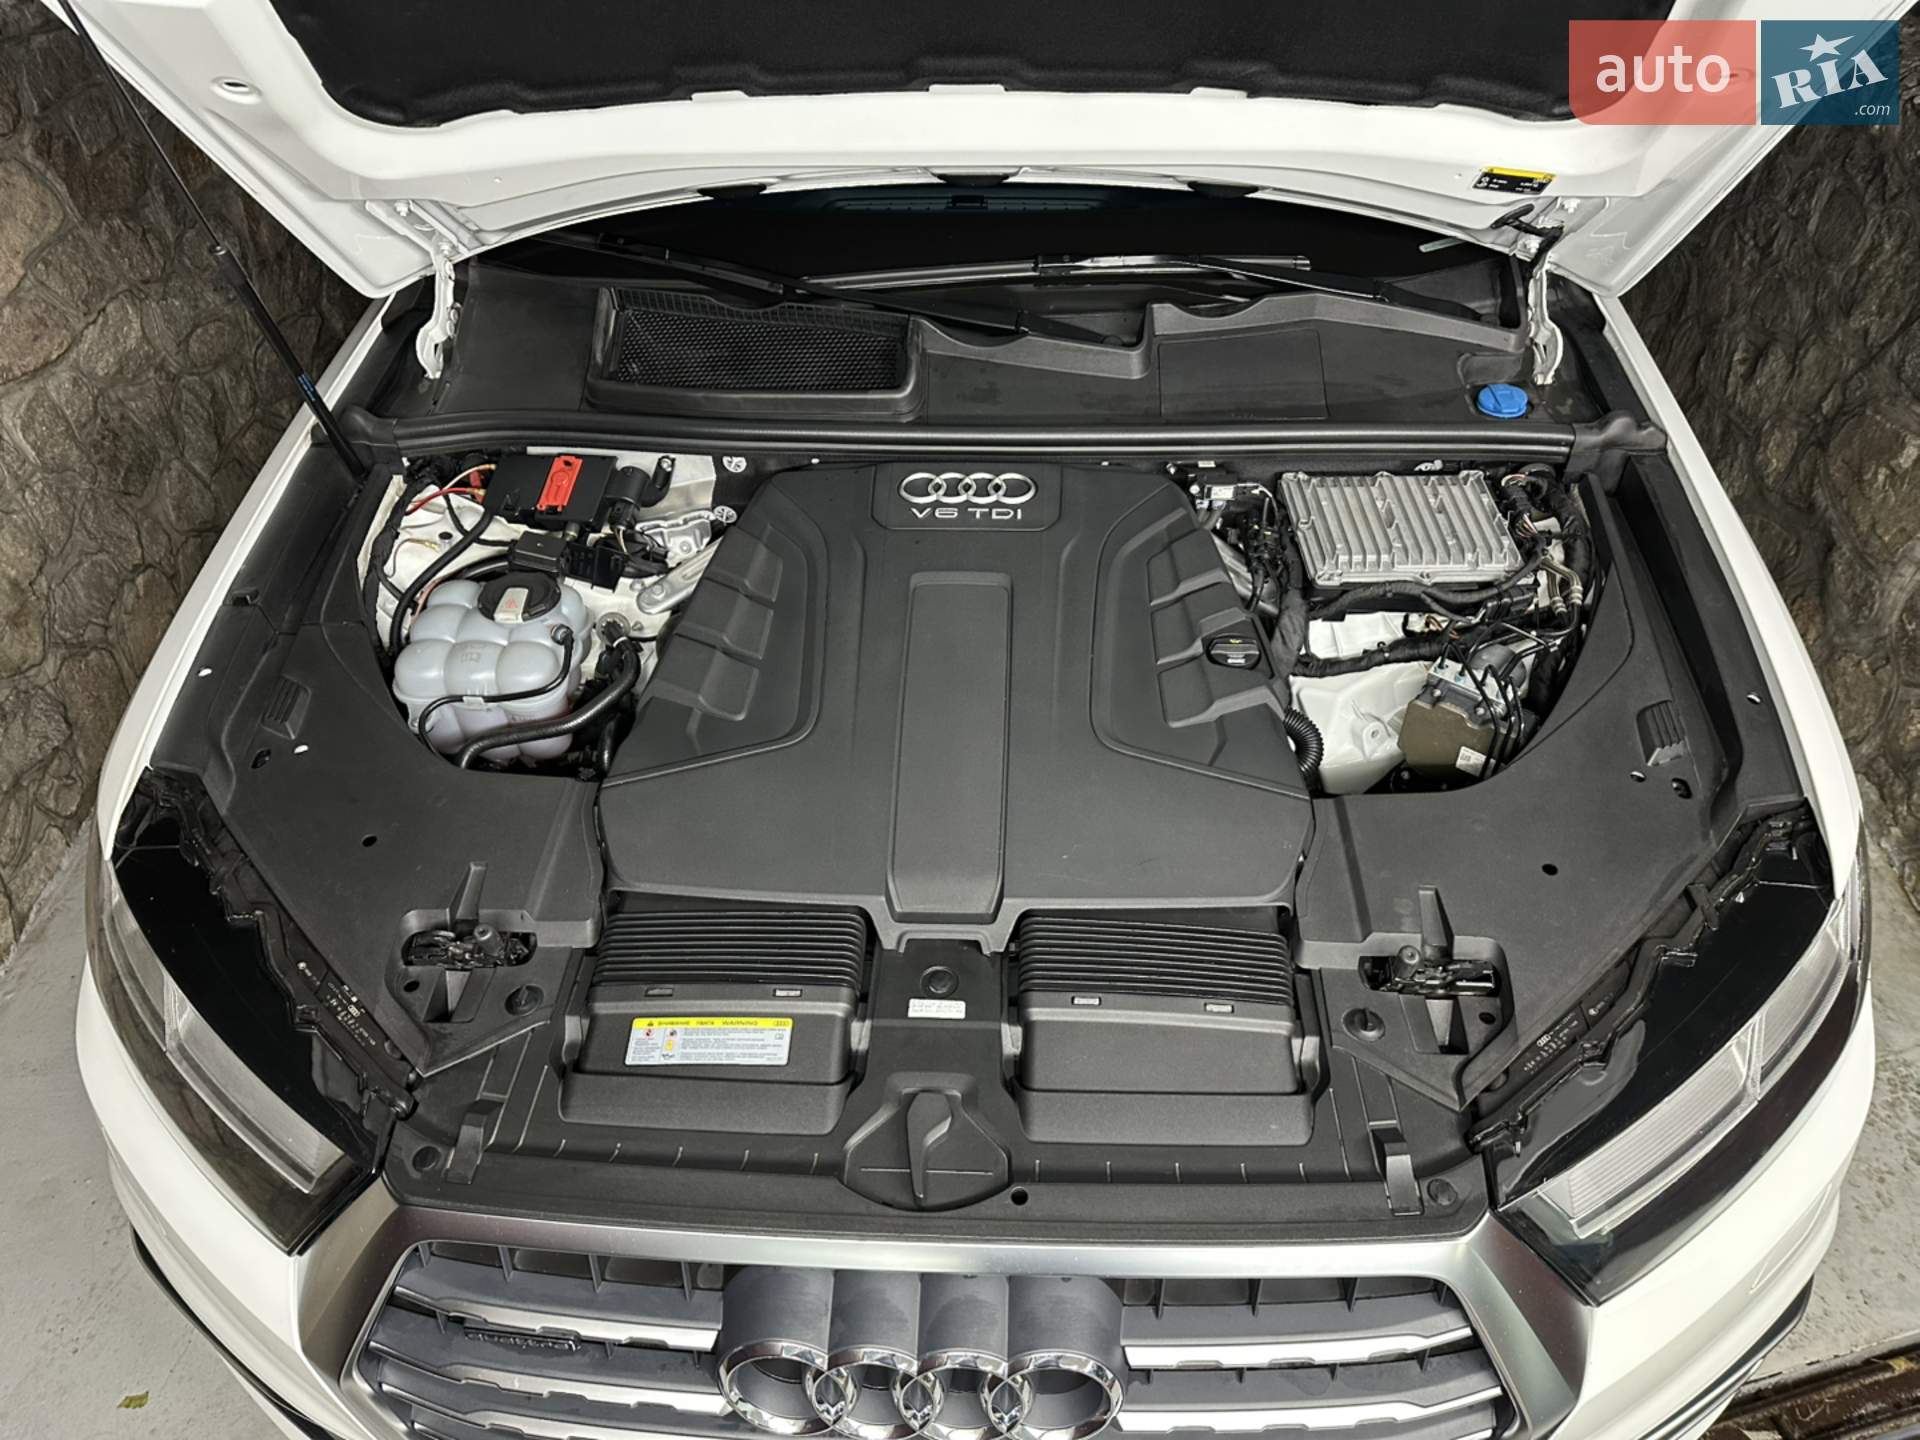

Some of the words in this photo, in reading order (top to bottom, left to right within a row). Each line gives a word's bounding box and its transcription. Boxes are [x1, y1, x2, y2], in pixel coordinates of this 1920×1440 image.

[910, 507, 958, 519] V6
[967, 507, 1022, 520] TDI
[722, 1019, 758, 1027] WARNING
